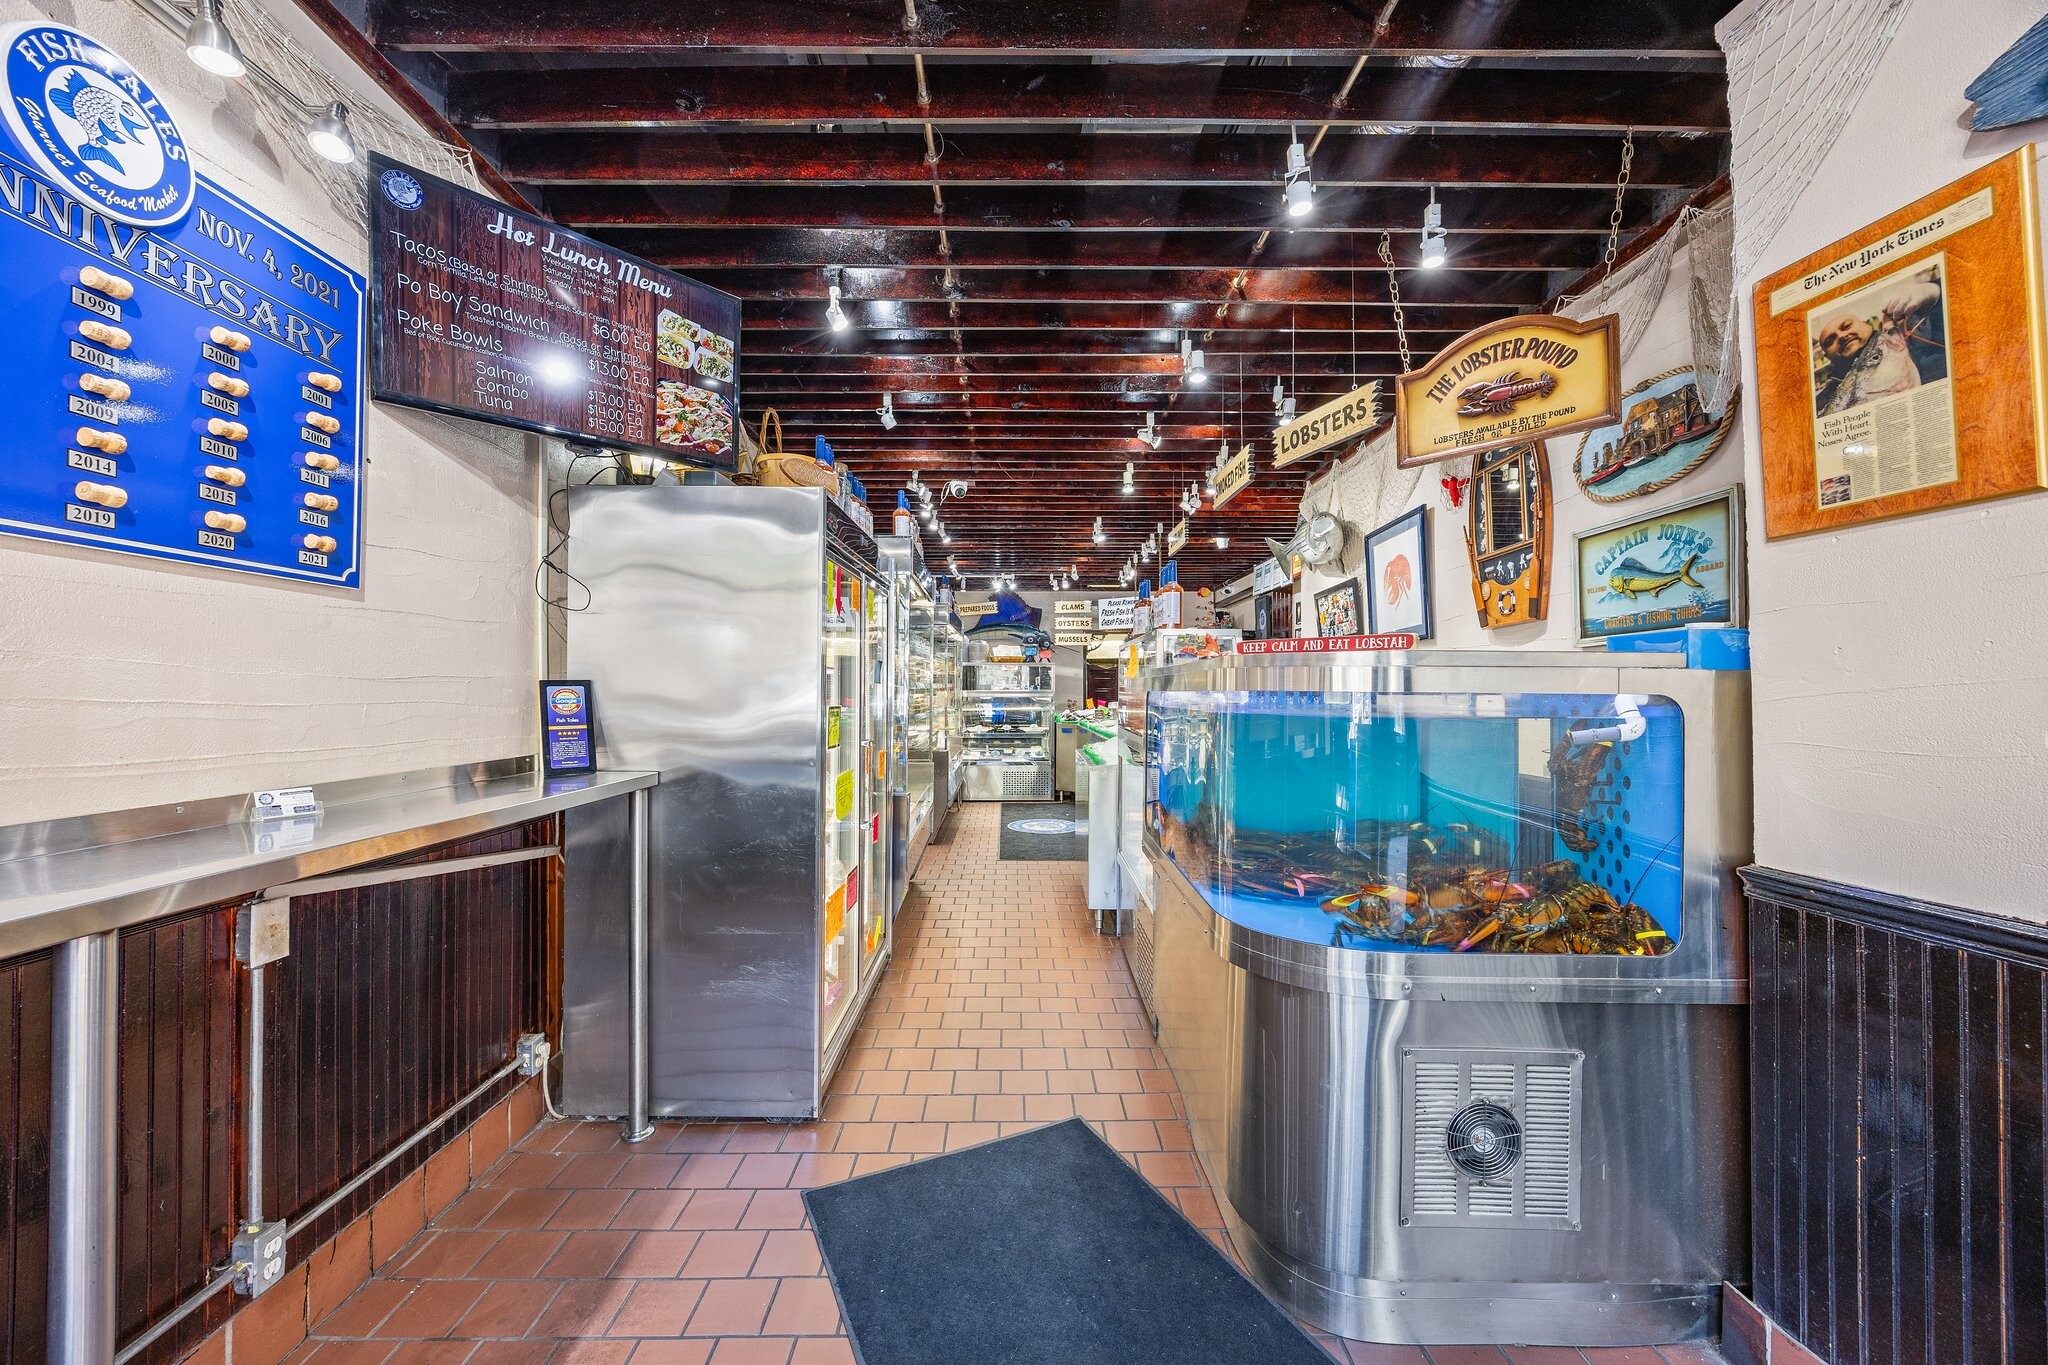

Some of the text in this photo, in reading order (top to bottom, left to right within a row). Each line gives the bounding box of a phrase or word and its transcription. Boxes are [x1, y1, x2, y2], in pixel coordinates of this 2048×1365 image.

[16, 32, 187, 163] FISH ALES
[15, 95, 179, 212] Gourmet Seafood Market
[197, 206, 340, 311] NOV. 4, 2021
[417, 256, 437, 268] Corn
[487, 212, 673, 299] Hot Lunch Menu
[1804, 217, 1945, 290] The New York Times
[389, 230, 548, 298] Tacos (Basa or Shrimp)
[541, 254, 577, 274] Weekdays
[542, 264, 575, 283] Saturday
[546, 275, 572, 292] Sunday
[79, 292, 116, 316] 1999
[397, 272, 641, 363] Po Boy Sandwich (Basa or Shrimp)
[464, 311, 495, 327] Toasted
[397, 308, 504, 352] Poke Bowls
[403, 327, 416, 337] Bed
[592, 323, 629, 345] $6.00
[77, 346, 115, 369] 2004
[208, 347, 236, 368] 2000
[475, 360, 534, 387] Salmon
[588, 358, 652, 388] $13.00 Ea.
[1426, 337, 1579, 403] THE LOBSTER POUND
[306, 389, 329, 405] 2001
[476, 377, 529, 400] Combo
[207, 394, 235, 413] 2005
[473, 389, 514, 411] Tuna
[587, 389, 624, 408] $13.00
[76, 400, 114, 421] 2009
[588, 403, 623, 422] $14.00
[1824, 410, 1871, 430] Fish People
[588, 417, 625, 435] $15.00
[1281, 398, 1367, 454] LOBSTERS
[1433, 406, 1576, 445] LOBSTERS AVAILABLE BY THE POUND
[1455, 420, 1547, 447] FRESH OR BOILED
[1822, 420, 1872, 439] With Heart.
[305, 430, 328, 446] 2006
[1817, 430, 1872, 449] Noses Agree.
[206, 440, 234, 458] 2010
[74, 453, 112, 473] 2014
[1234, 457, 1246, 482] FISH
[304, 472, 327, 486] 2011
[205, 487, 234, 503] 2015
[73, 507, 111, 525] 2019
[303, 512, 326, 526] 2016
[203, 533, 232, 549] 2020
[1594, 523, 1714, 576] CAPTAIN JOHN'S
[302, 553, 325, 565] 2021
[1695, 561, 1725, 574] ABOARD
[1587, 585, 1607, 594] WELCOME
[960, 605, 981, 613] PREPARED
[1061, 603, 1085, 611] CLAMS
[1101, 609, 1115, 617] FRESH
[1115, 608, 1125, 616] FISH
[1115, 617, 1125, 625] FISH
[1604, 605, 1703, 630] CHARTERS & FISHING GUIDES
[1243, 636, 1408, 653] KEEP CALM AND EAT LOBSTAH
[555, 697, 578, 705] Google
